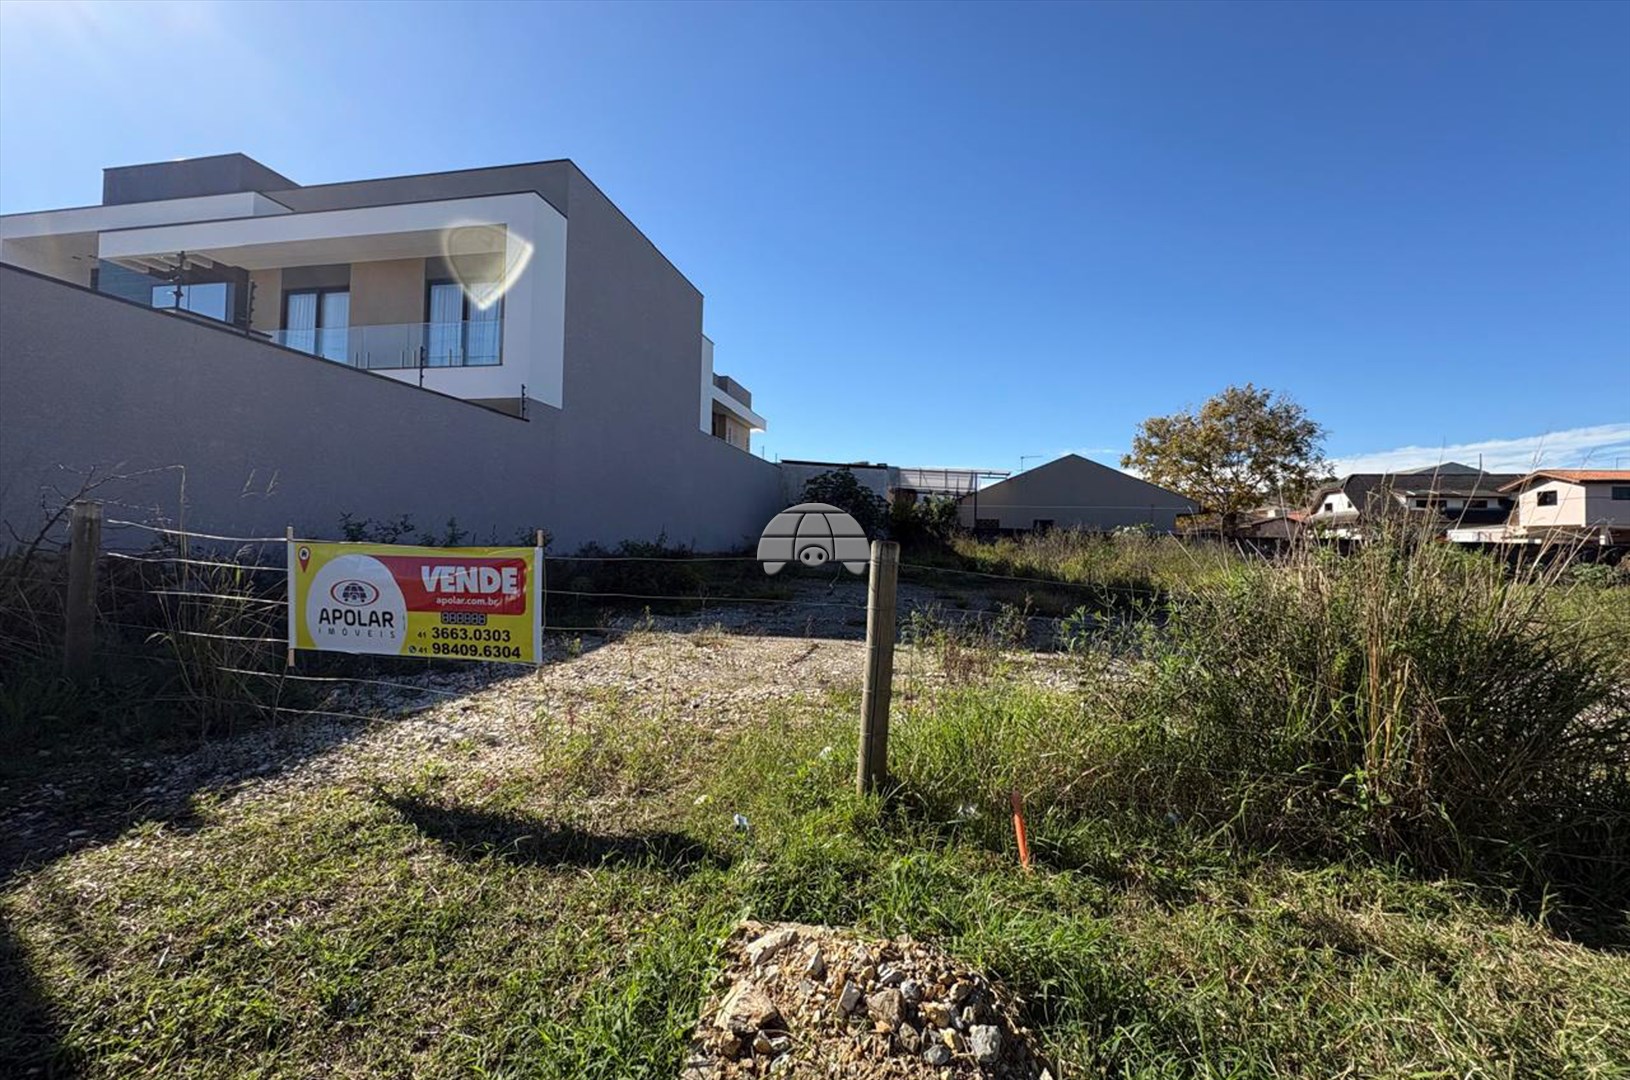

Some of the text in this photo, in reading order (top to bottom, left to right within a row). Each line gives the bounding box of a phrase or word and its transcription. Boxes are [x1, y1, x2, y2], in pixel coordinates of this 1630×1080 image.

[421, 565, 518, 595] VENDE
[436, 596, 498, 606] apolar.com.br
[319, 608, 395, 628] APOLAR
[417, 626, 511, 642] 41 3663.0303
[418, 642, 521, 659] 41 98409.6304
